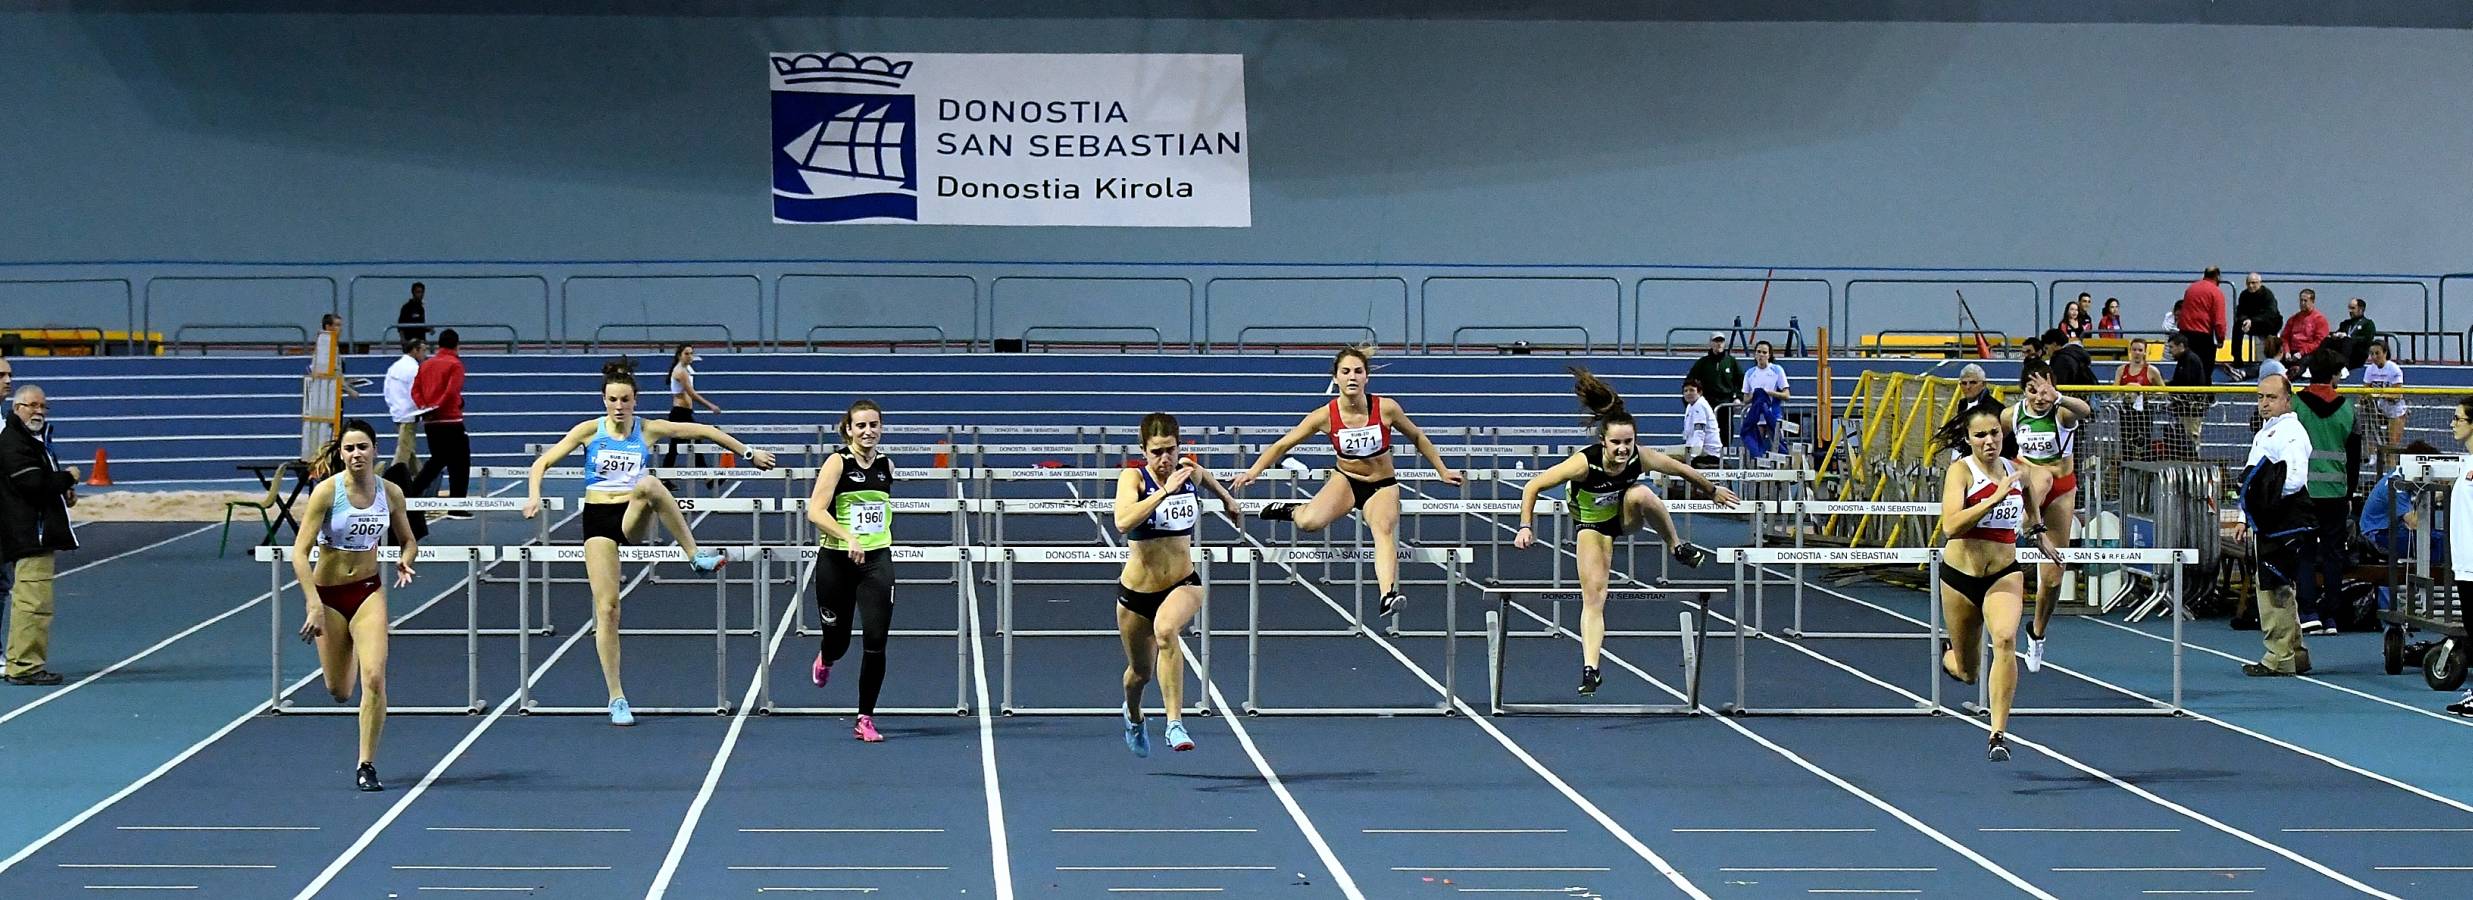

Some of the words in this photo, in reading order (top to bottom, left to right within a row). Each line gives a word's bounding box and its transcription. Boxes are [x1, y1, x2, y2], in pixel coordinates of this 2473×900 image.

[938, 98, 1129, 124] DONOSTIA
[937, 133, 1012, 156] SAN
[1028, 131, 1242, 158] SEBASTIAN
[937, 175, 1081, 200] Donostia
[1095, 176, 1194, 200] Kirola
[1345, 436, 1376, 449] 2171
[602, 460, 635, 472] 2917
[475, 500, 515, 508] SEBASTIAN
[1422, 502, 1459, 510] DONOSTIA
[1466, 502, 1481, 510] SAN
[1482, 502, 1521, 510] SEBASTIAN
[857, 511, 884, 524] 1960
[1163, 505, 1194, 520] 1648
[1990, 506, 2018, 520] 1882
[349, 523, 384, 535] 2067
[558, 550, 584, 558] DONO
[632, 550, 680, 559] SEBASTIAN
[893, 550, 924, 558] ASTIAN
[1045, 551, 1090, 559] DONOSTIA
[1098, 551, 1117, 559] SAN
[1289, 551, 1334, 560] DONOSTIA
[1342, 551, 1360, 560] SAN
[1777, 552, 1821, 560] DONOSTIA
[1830, 552, 1848, 560] SAN
[1850, 552, 1899, 560] SEBASTIAN
[2074, 552, 2092, 560] SAN
